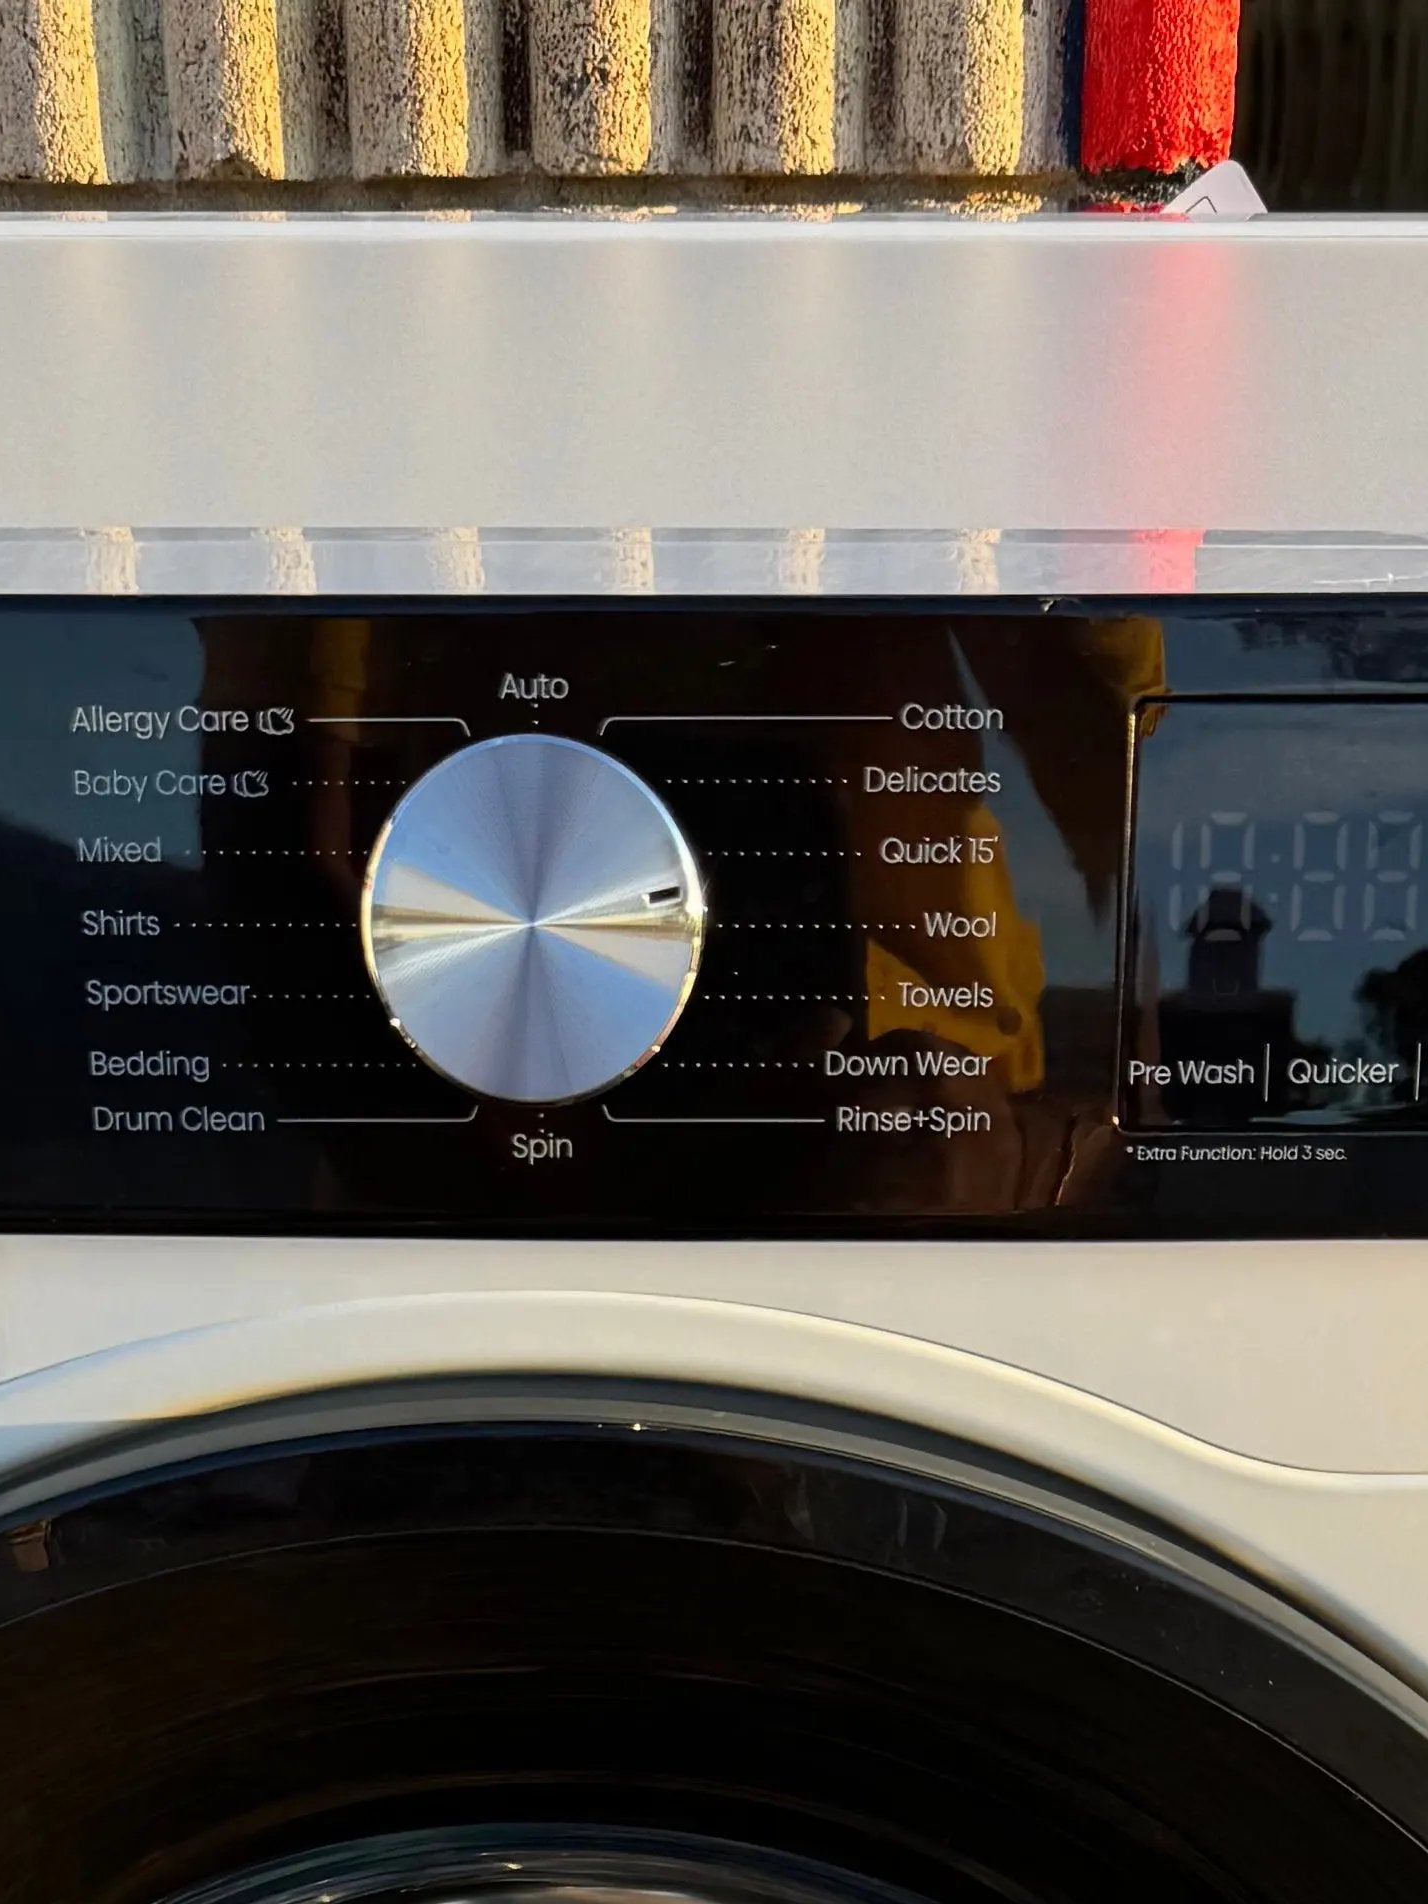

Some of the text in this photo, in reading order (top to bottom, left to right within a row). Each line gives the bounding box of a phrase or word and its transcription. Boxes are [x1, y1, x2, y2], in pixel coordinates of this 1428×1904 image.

[499, 673, 570, 701] Auto
[71, 706, 250, 740] Allergy Care
[899, 703, 1005, 731] Cotton
[73, 770, 226, 803] Baby Care
[863, 766, 1001, 794] Delicates
[77, 837, 162, 863] Mixed
[880, 837, 962, 866] Quick
[82, 910, 161, 937] Shirts
[924, 911, 998, 938] Wool
[85, 979, 251, 1012] Sportswear
[898, 981, 995, 1008] Towels
[90, 1050, 210, 1083] Bedding
[824, 1050, 992, 1077] Down Wear
[1128, 1059, 1255, 1086] Pre Wash
[1288, 1058, 1400, 1085] Quicker
[92, 1106, 265, 1132] Drum Clean
[836, 1106, 992, 1138] Rinse+Spin
[511, 1133, 573, 1164] Spin
[1137, 1145, 1347, 1162] Extra Function: Hold 3 sec.
